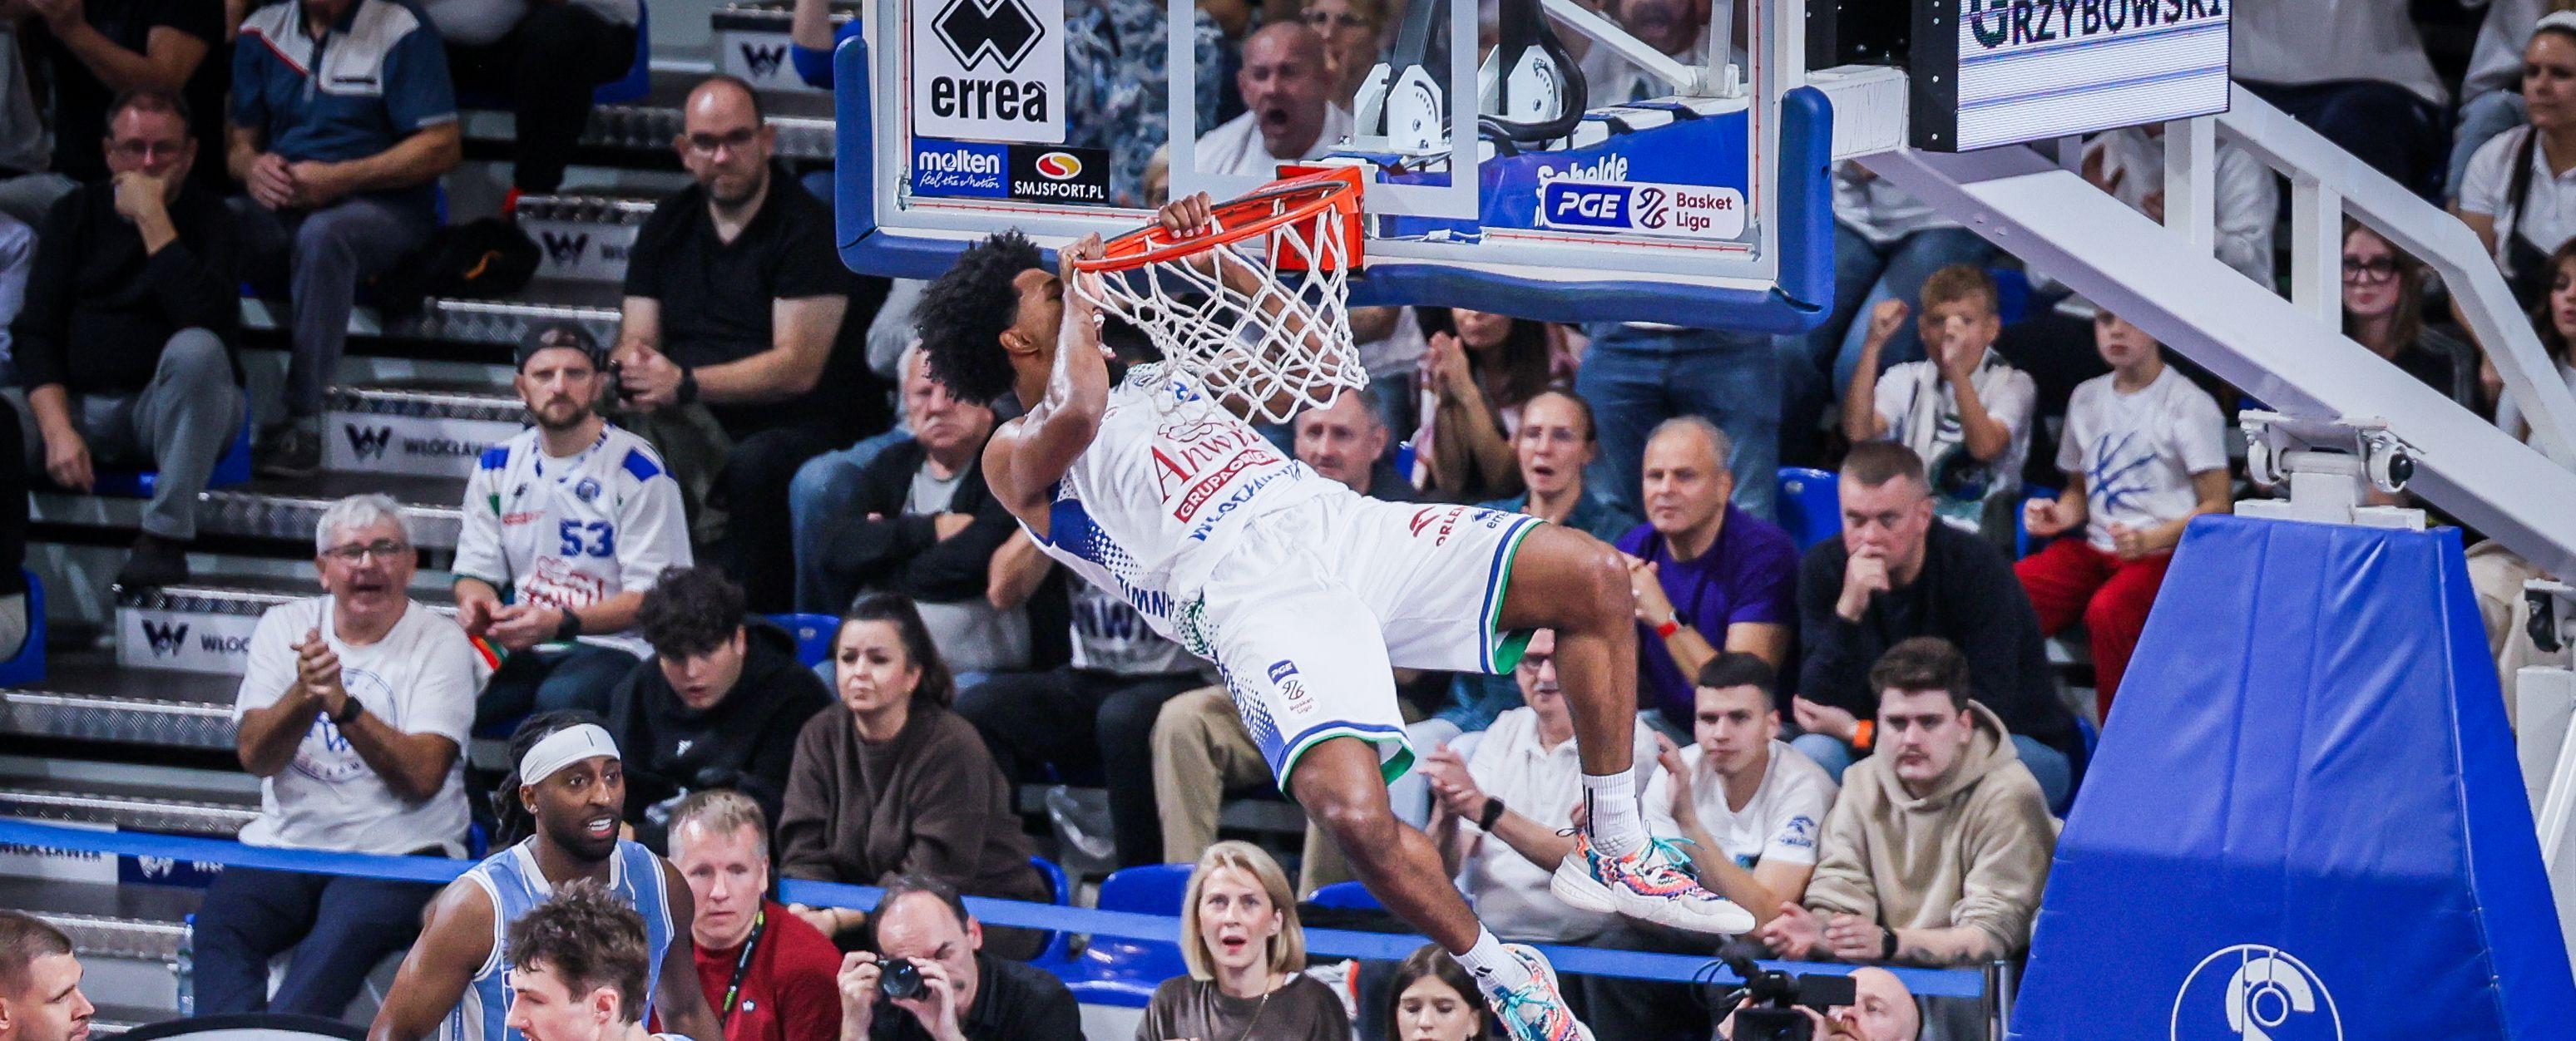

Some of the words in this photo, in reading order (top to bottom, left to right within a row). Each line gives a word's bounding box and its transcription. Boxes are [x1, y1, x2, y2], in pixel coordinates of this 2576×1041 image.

[918, 149, 1001, 175] molten
[1014, 180, 1105, 200] SMJSPORT.PL
[1557, 191, 1621, 219] PGE
[1676, 192, 1733, 211] Basket
[1676, 212, 1711, 232] Liga
[559, 519, 614, 557] 53
[1271, 662, 1293, 679] PGE
